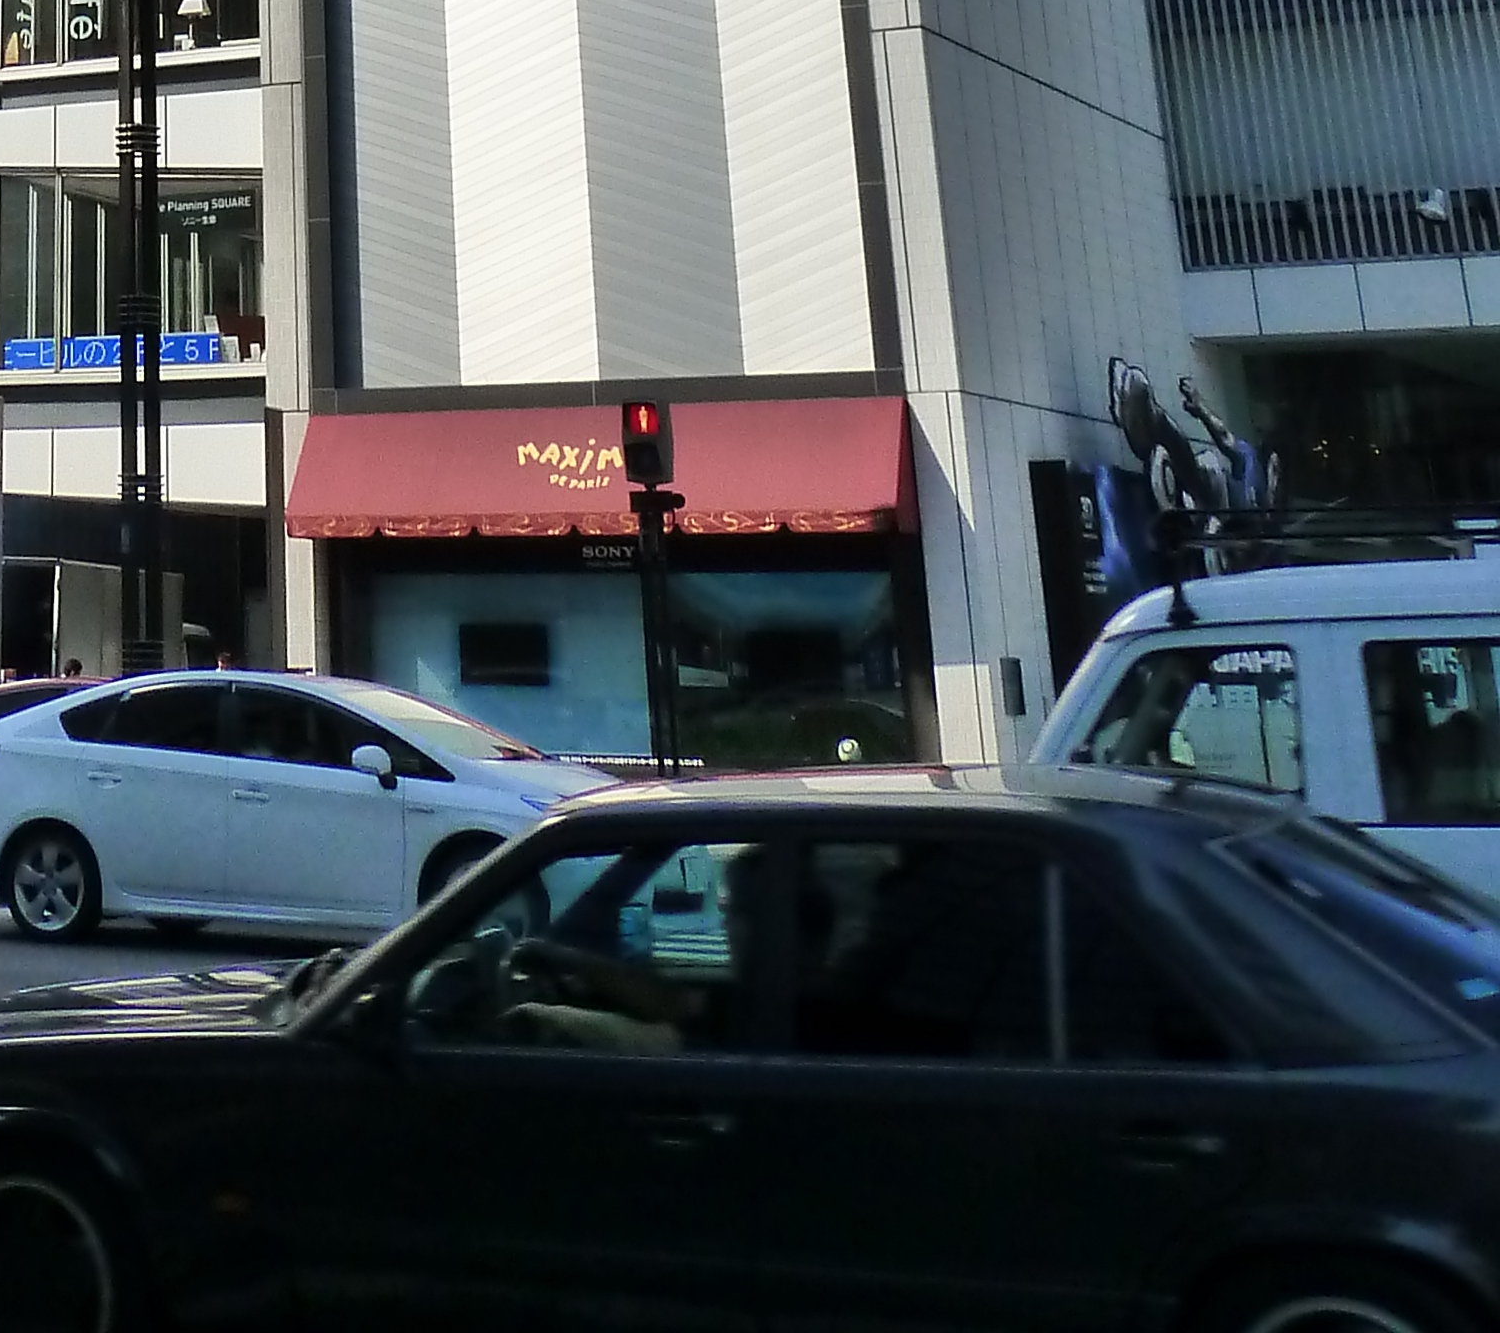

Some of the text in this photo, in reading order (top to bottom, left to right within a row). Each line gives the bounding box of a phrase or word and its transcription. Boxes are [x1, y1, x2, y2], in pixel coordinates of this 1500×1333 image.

[167, 200, 209, 213] Planning
[211, 195, 252, 210] SQUARE
[582, 545, 635, 559] SONY
